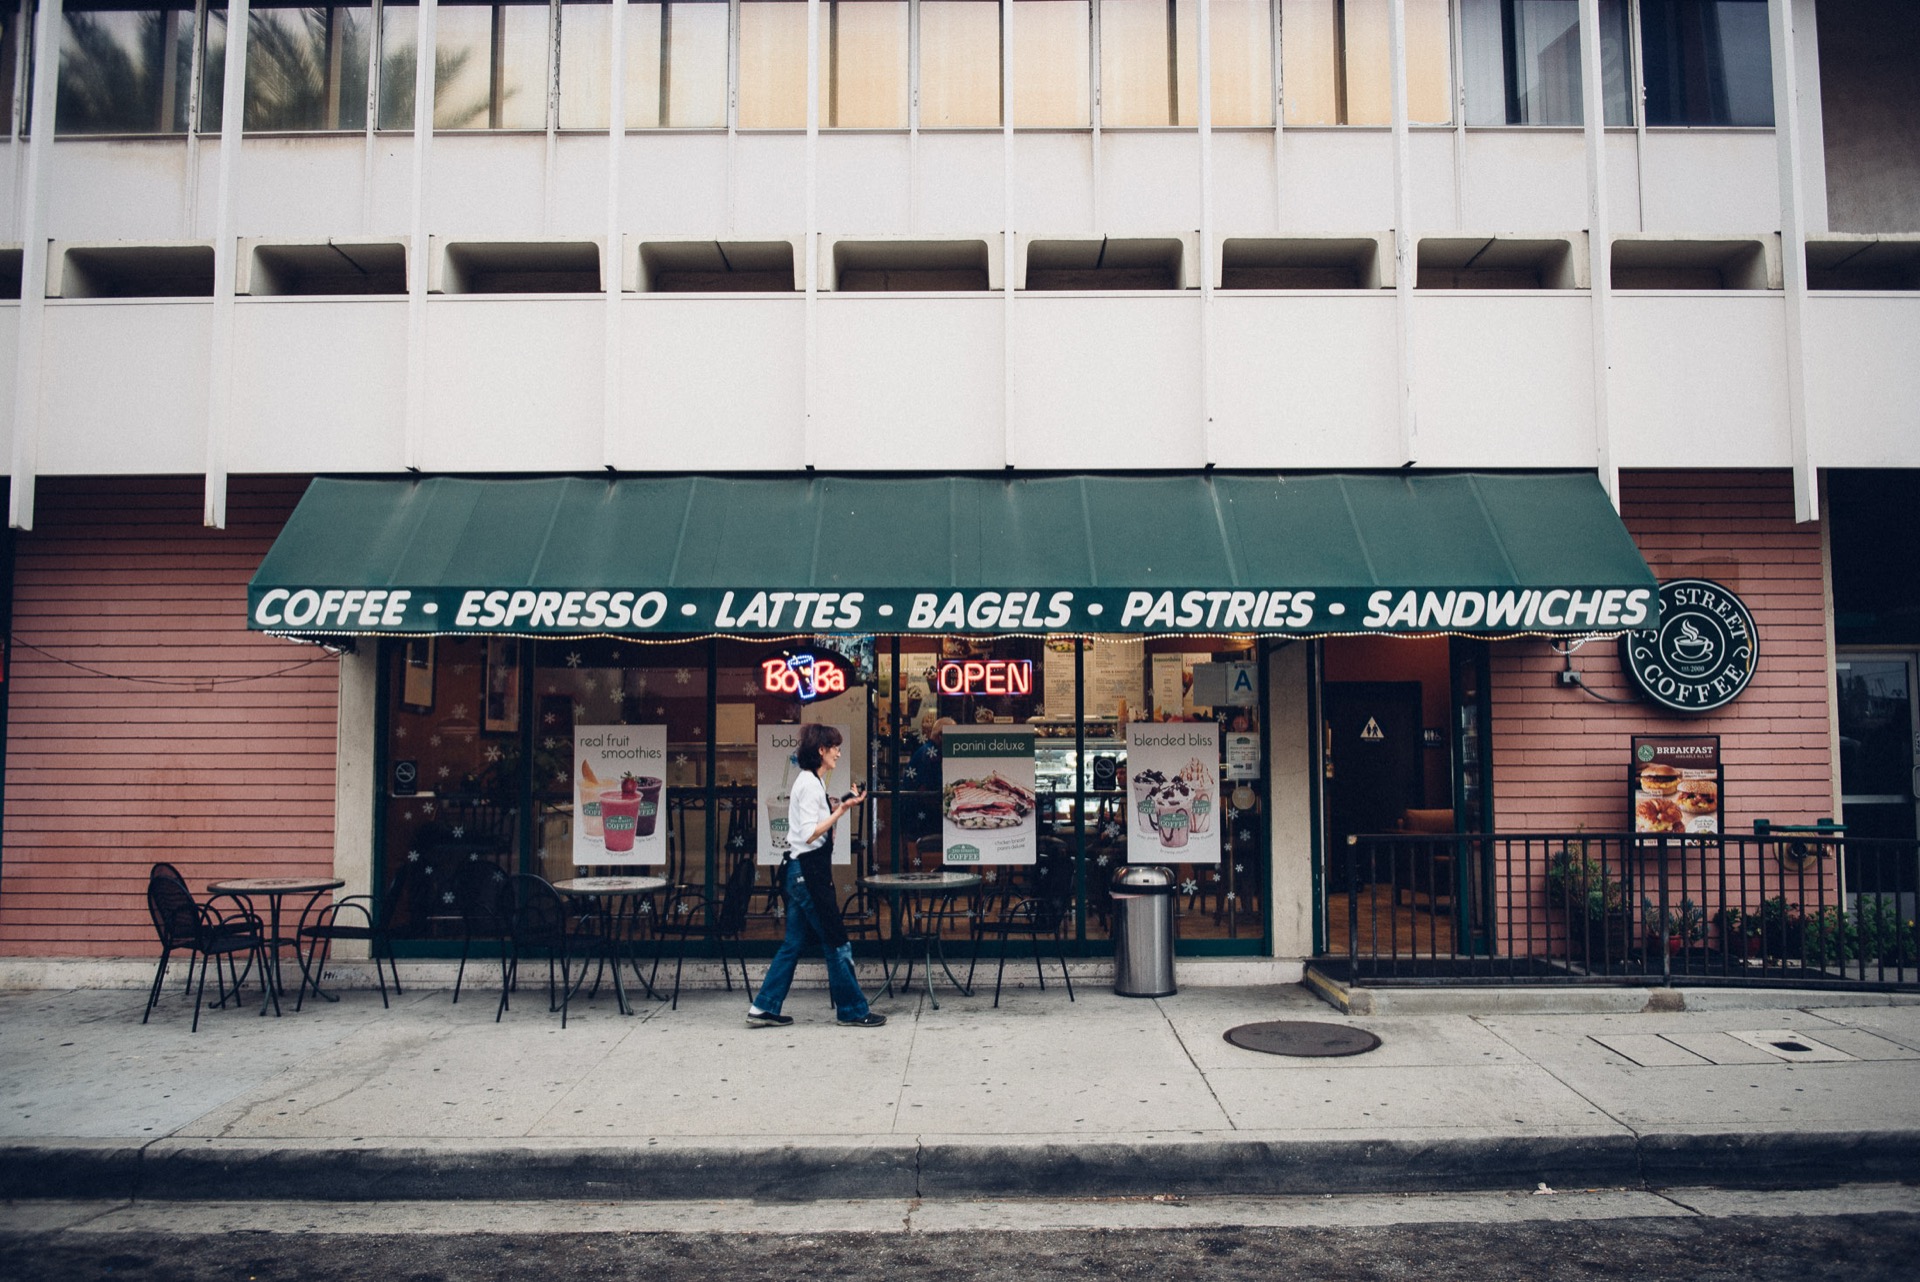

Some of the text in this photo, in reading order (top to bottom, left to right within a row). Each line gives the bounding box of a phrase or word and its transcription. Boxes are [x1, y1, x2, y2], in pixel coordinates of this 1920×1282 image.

[256, 589, 411, 626] COFFEE
[456, 591, 667, 627] ESPRESSO
[715, 592, 864, 628] LATTES
[908, 592, 1073, 628] BAGELS
[1121, 591, 1315, 628] PASTRIES
[1363, 590, 1649, 627] SANDWICHES
[1674, 588, 1749, 640] STREET
[941, 663, 1028, 693] OPEN
[1234, 670, 1252, 691] A
[1644, 664, 1745, 704] COFFEE
[580, 734, 630, 747] real fruit
[952, 739, 1025, 755] panini deluxe
[1134, 733, 1213, 746] blended bliss
[601, 746, 662, 759] smoothies
[1656, 746, 1714, 755] BREAKFAST
